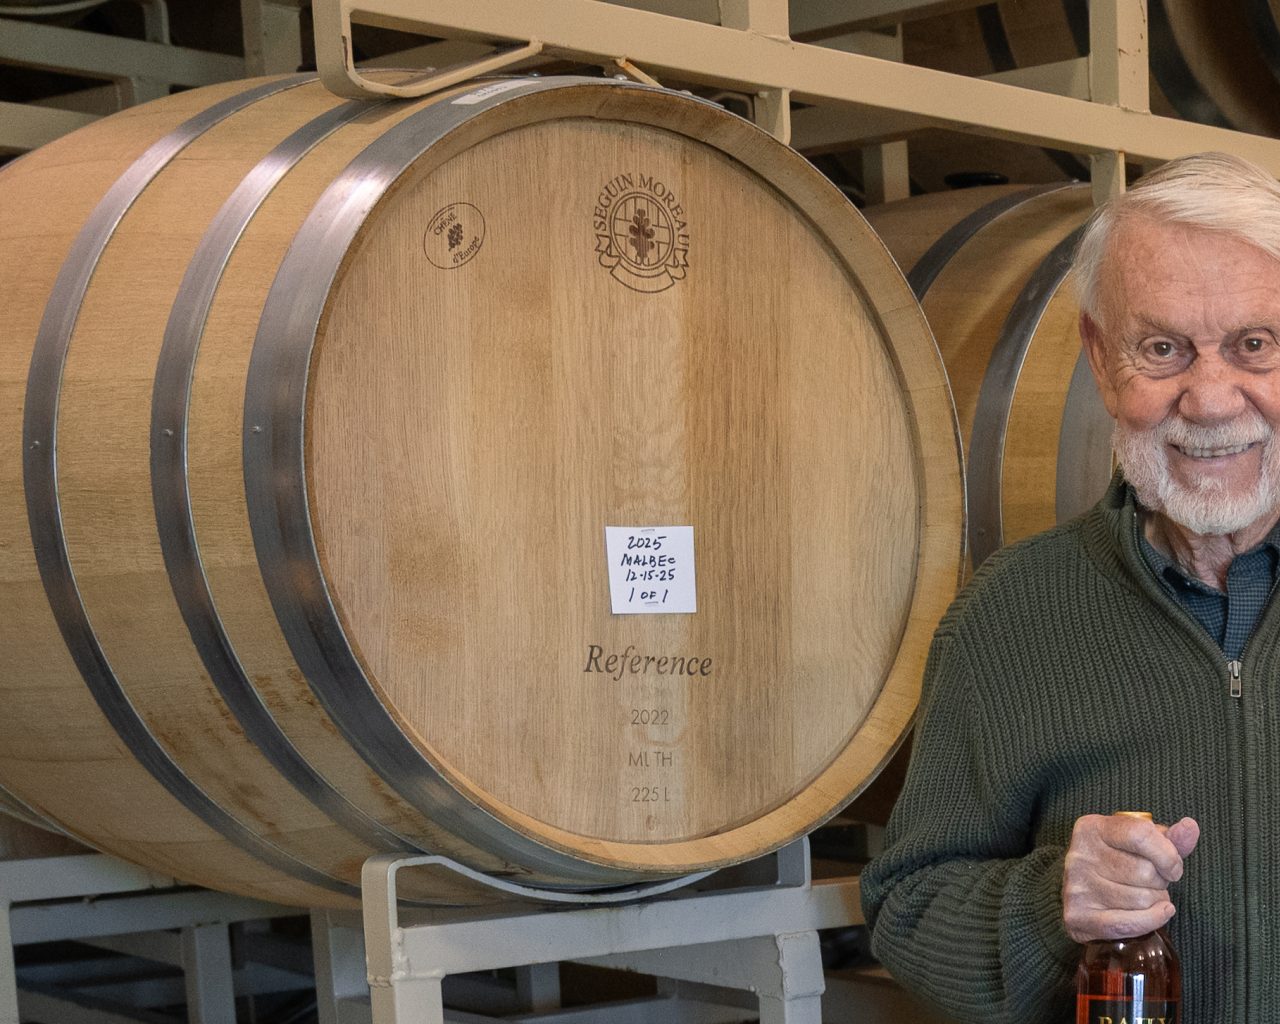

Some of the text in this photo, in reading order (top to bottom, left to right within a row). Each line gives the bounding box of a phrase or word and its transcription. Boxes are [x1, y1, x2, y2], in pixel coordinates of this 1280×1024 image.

[594, 172, 690, 249] SEGUIN MOREAU
[452, 235, 481, 264] d'Europe
[627, 536, 667, 550] 2025
[628, 587, 669, 603] 1 OF 1
[582, 644, 713, 682] Reference
[631, 709, 669, 726] 2022
[655, 752, 673, 768] TH
[631, 786, 660, 803] 225
